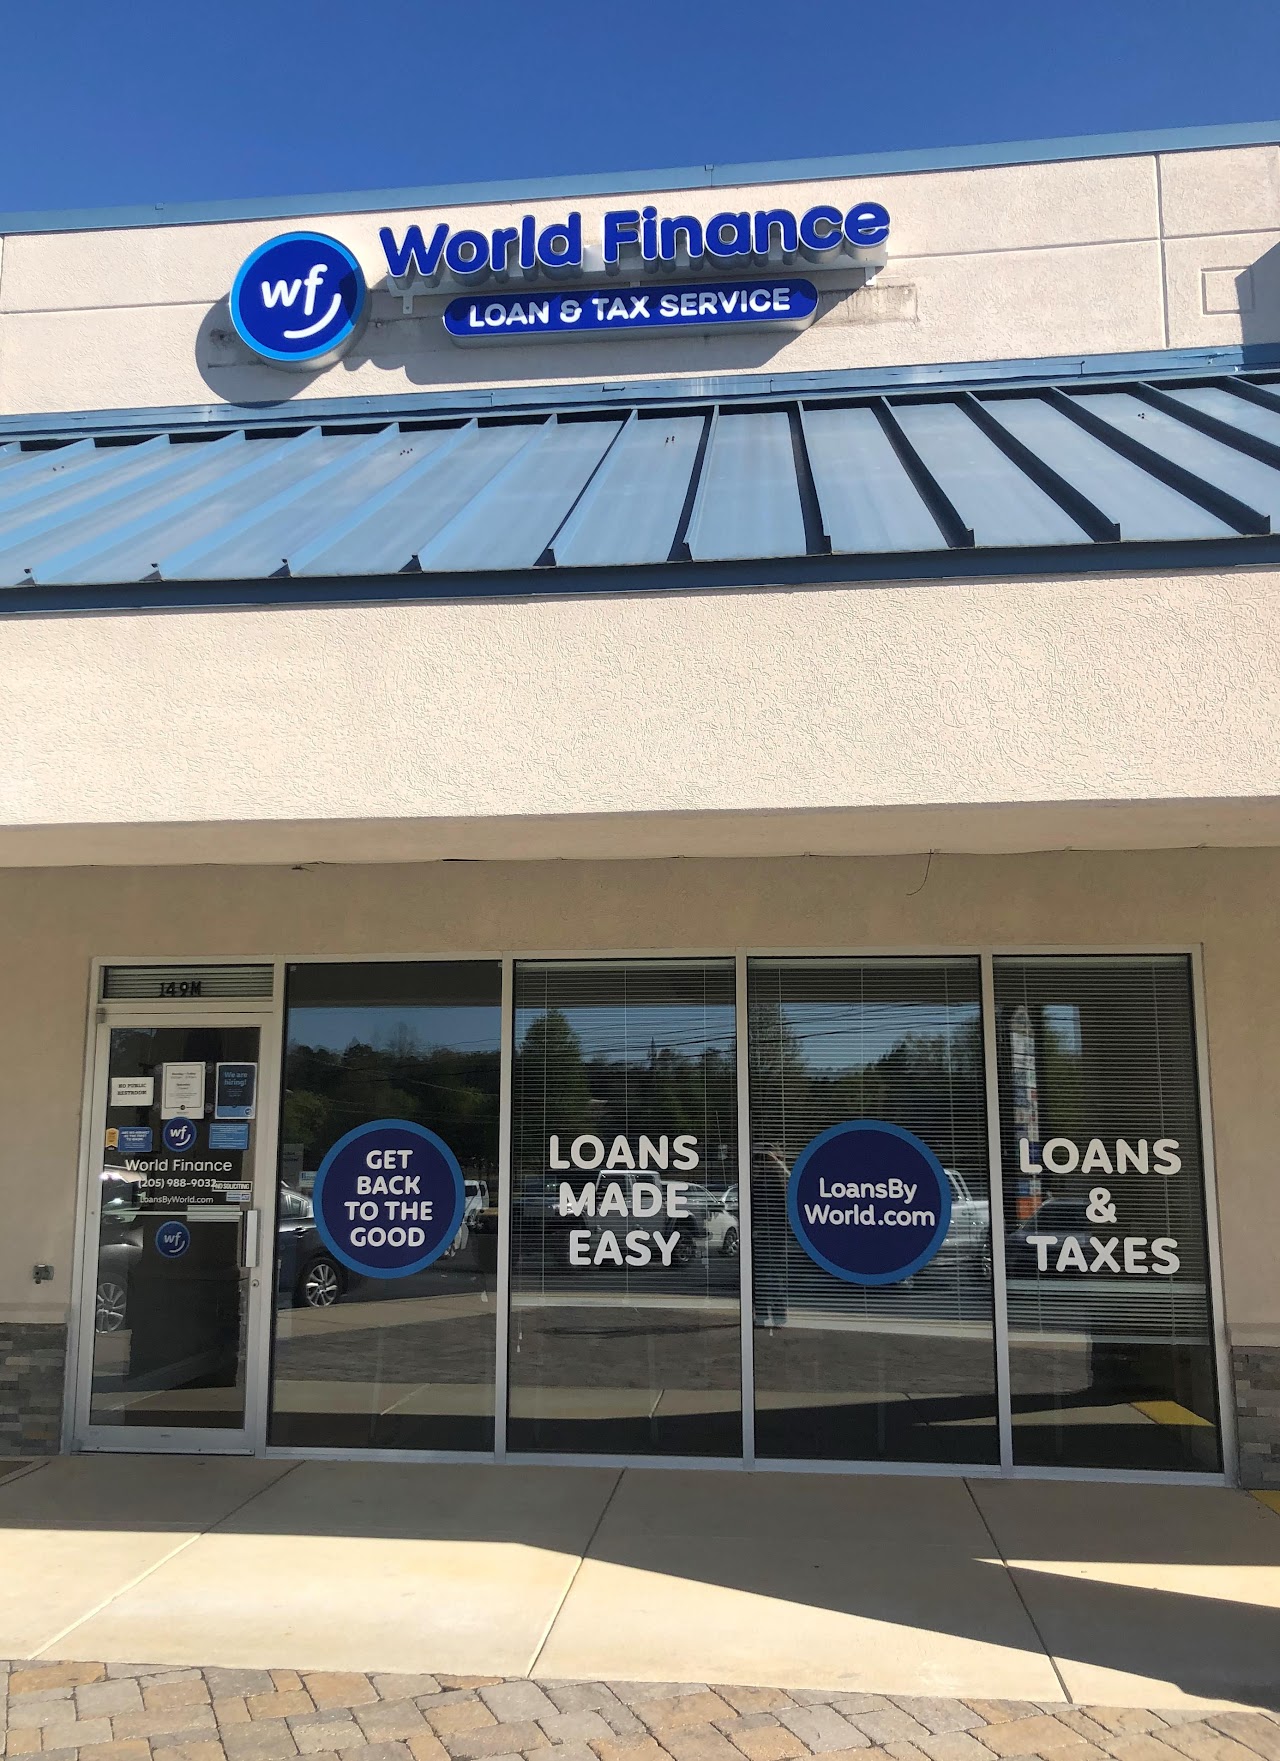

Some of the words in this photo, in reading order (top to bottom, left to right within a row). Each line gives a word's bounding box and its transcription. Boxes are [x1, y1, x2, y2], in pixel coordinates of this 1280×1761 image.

[379, 211, 582, 278] World
[602, 202, 892, 265] Finance
[261, 263, 328, 316] wf
[469, 302, 550, 328] LOAN
[559, 299, 583, 323] &
[591, 295, 651, 321] TAX
[659, 287, 791, 318] SERVICE
[160, 980, 202, 997] 149M
[169, 1125, 188, 1140] wf
[366, 1149, 414, 1170] GET
[549, 1134, 699, 1170] LOANS
[1019, 1137, 1182, 1175] LOANS
[125, 1158, 169, 1172] World
[172, 1159, 233, 1172] Finance
[138, 1178, 165, 1189] (205)
[166, 1178, 217, 1189] 988-9032
[356, 1175, 421, 1196] BACK
[819, 1177, 918, 1205] LoansBy
[139, 1195, 214, 1205] LoansByWorld.com
[343, 1200, 379, 1221] TO
[383, 1200, 434, 1221] THE
[558, 1181, 690, 1218] MADE
[1085, 1187, 1117, 1224] &
[803, 1203, 936, 1227] World.com
[163, 1231, 183, 1247] wf
[349, 1226, 426, 1247] GOOD
[569, 1229, 681, 1267] EASY
[1025, 1235, 1181, 1275] TAXES
